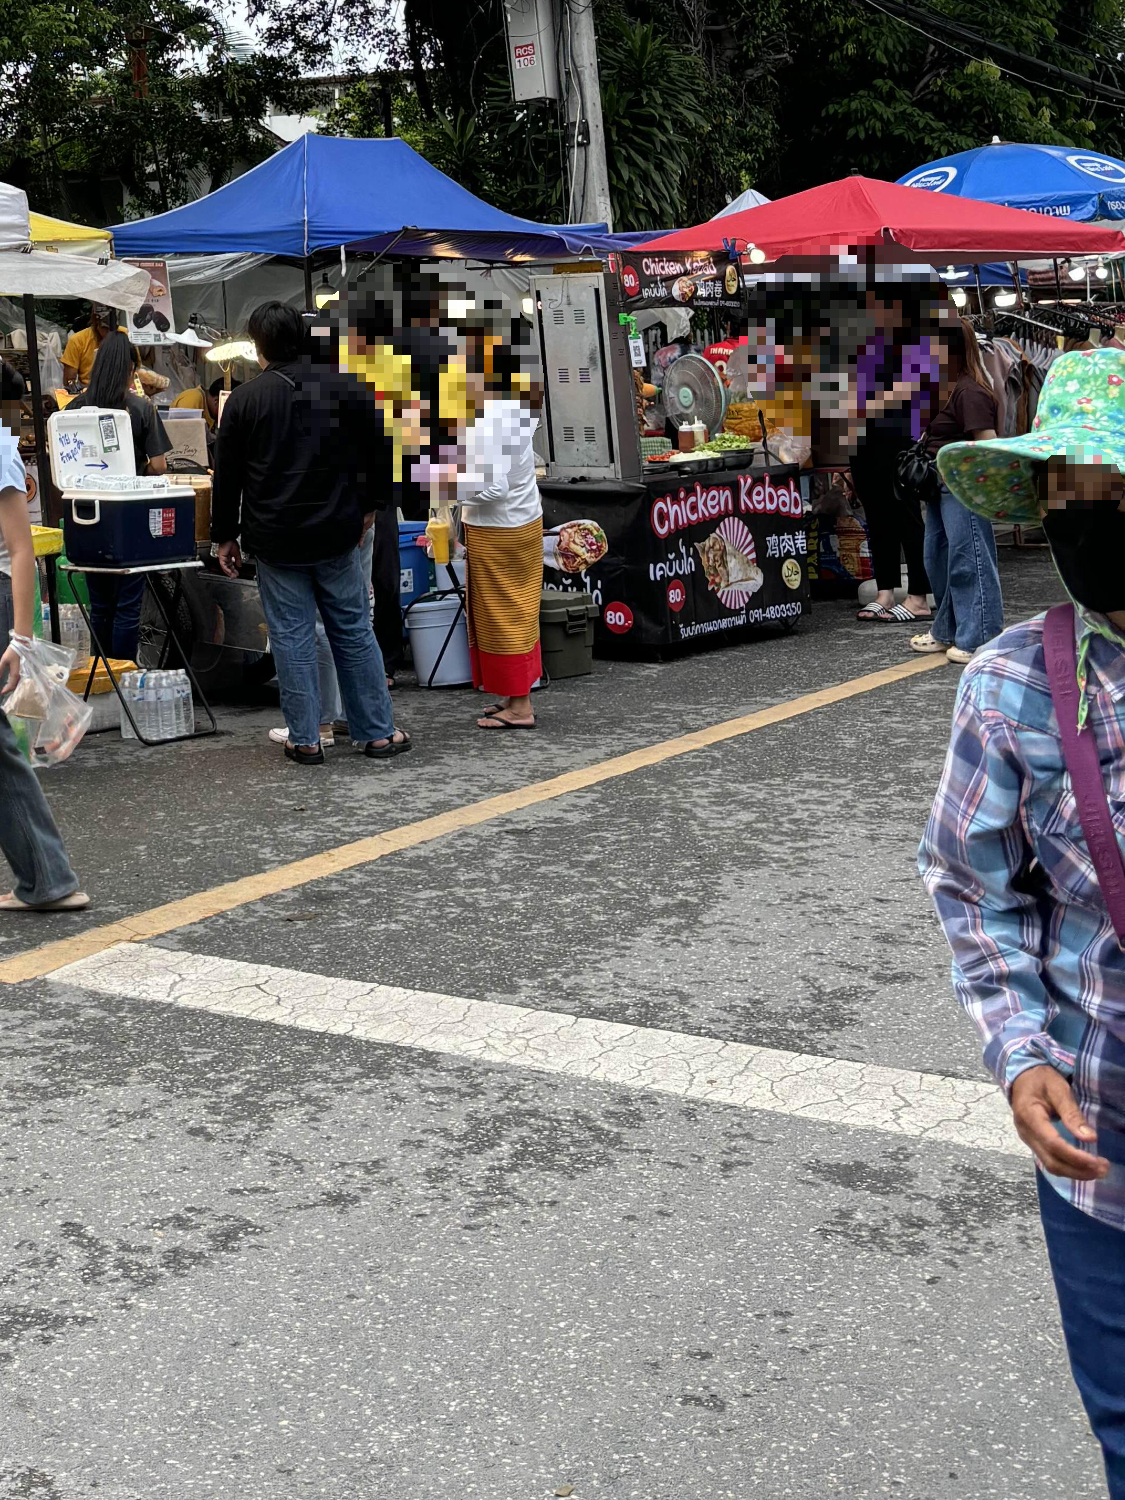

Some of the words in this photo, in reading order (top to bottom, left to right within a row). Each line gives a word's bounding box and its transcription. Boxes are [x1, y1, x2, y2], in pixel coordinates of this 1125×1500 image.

[515, 45, 534, 56] RCS
[516, 57, 536, 68] 106
[642, 257, 685, 275] Chicken
[652, 483, 733, 536] Chicken
[739, 473, 802, 515] Kebab
[765, 530, 807, 559] 鸡肉卷
[649, 538, 696, 581] เคบับไก่
[749, 601, 802, 623] 091-4803350
